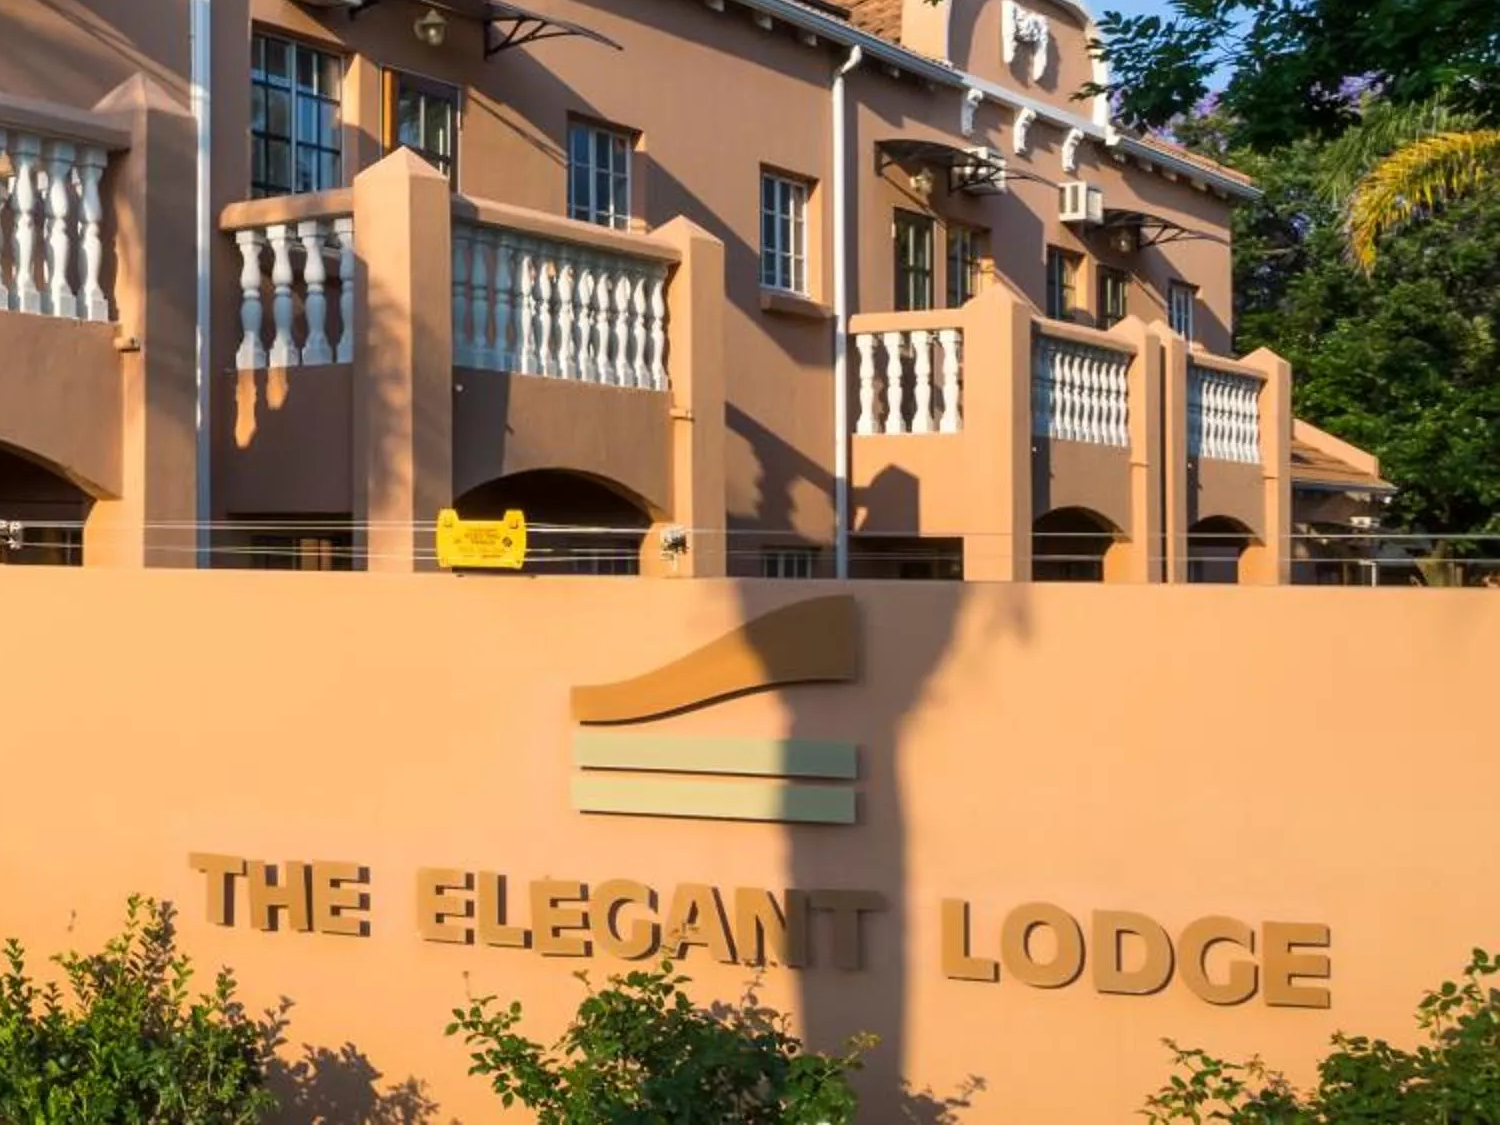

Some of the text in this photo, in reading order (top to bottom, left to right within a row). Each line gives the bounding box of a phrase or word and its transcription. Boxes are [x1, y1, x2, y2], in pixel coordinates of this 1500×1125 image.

[189, 852, 1331, 1009] THE ELEGANT LODGE
